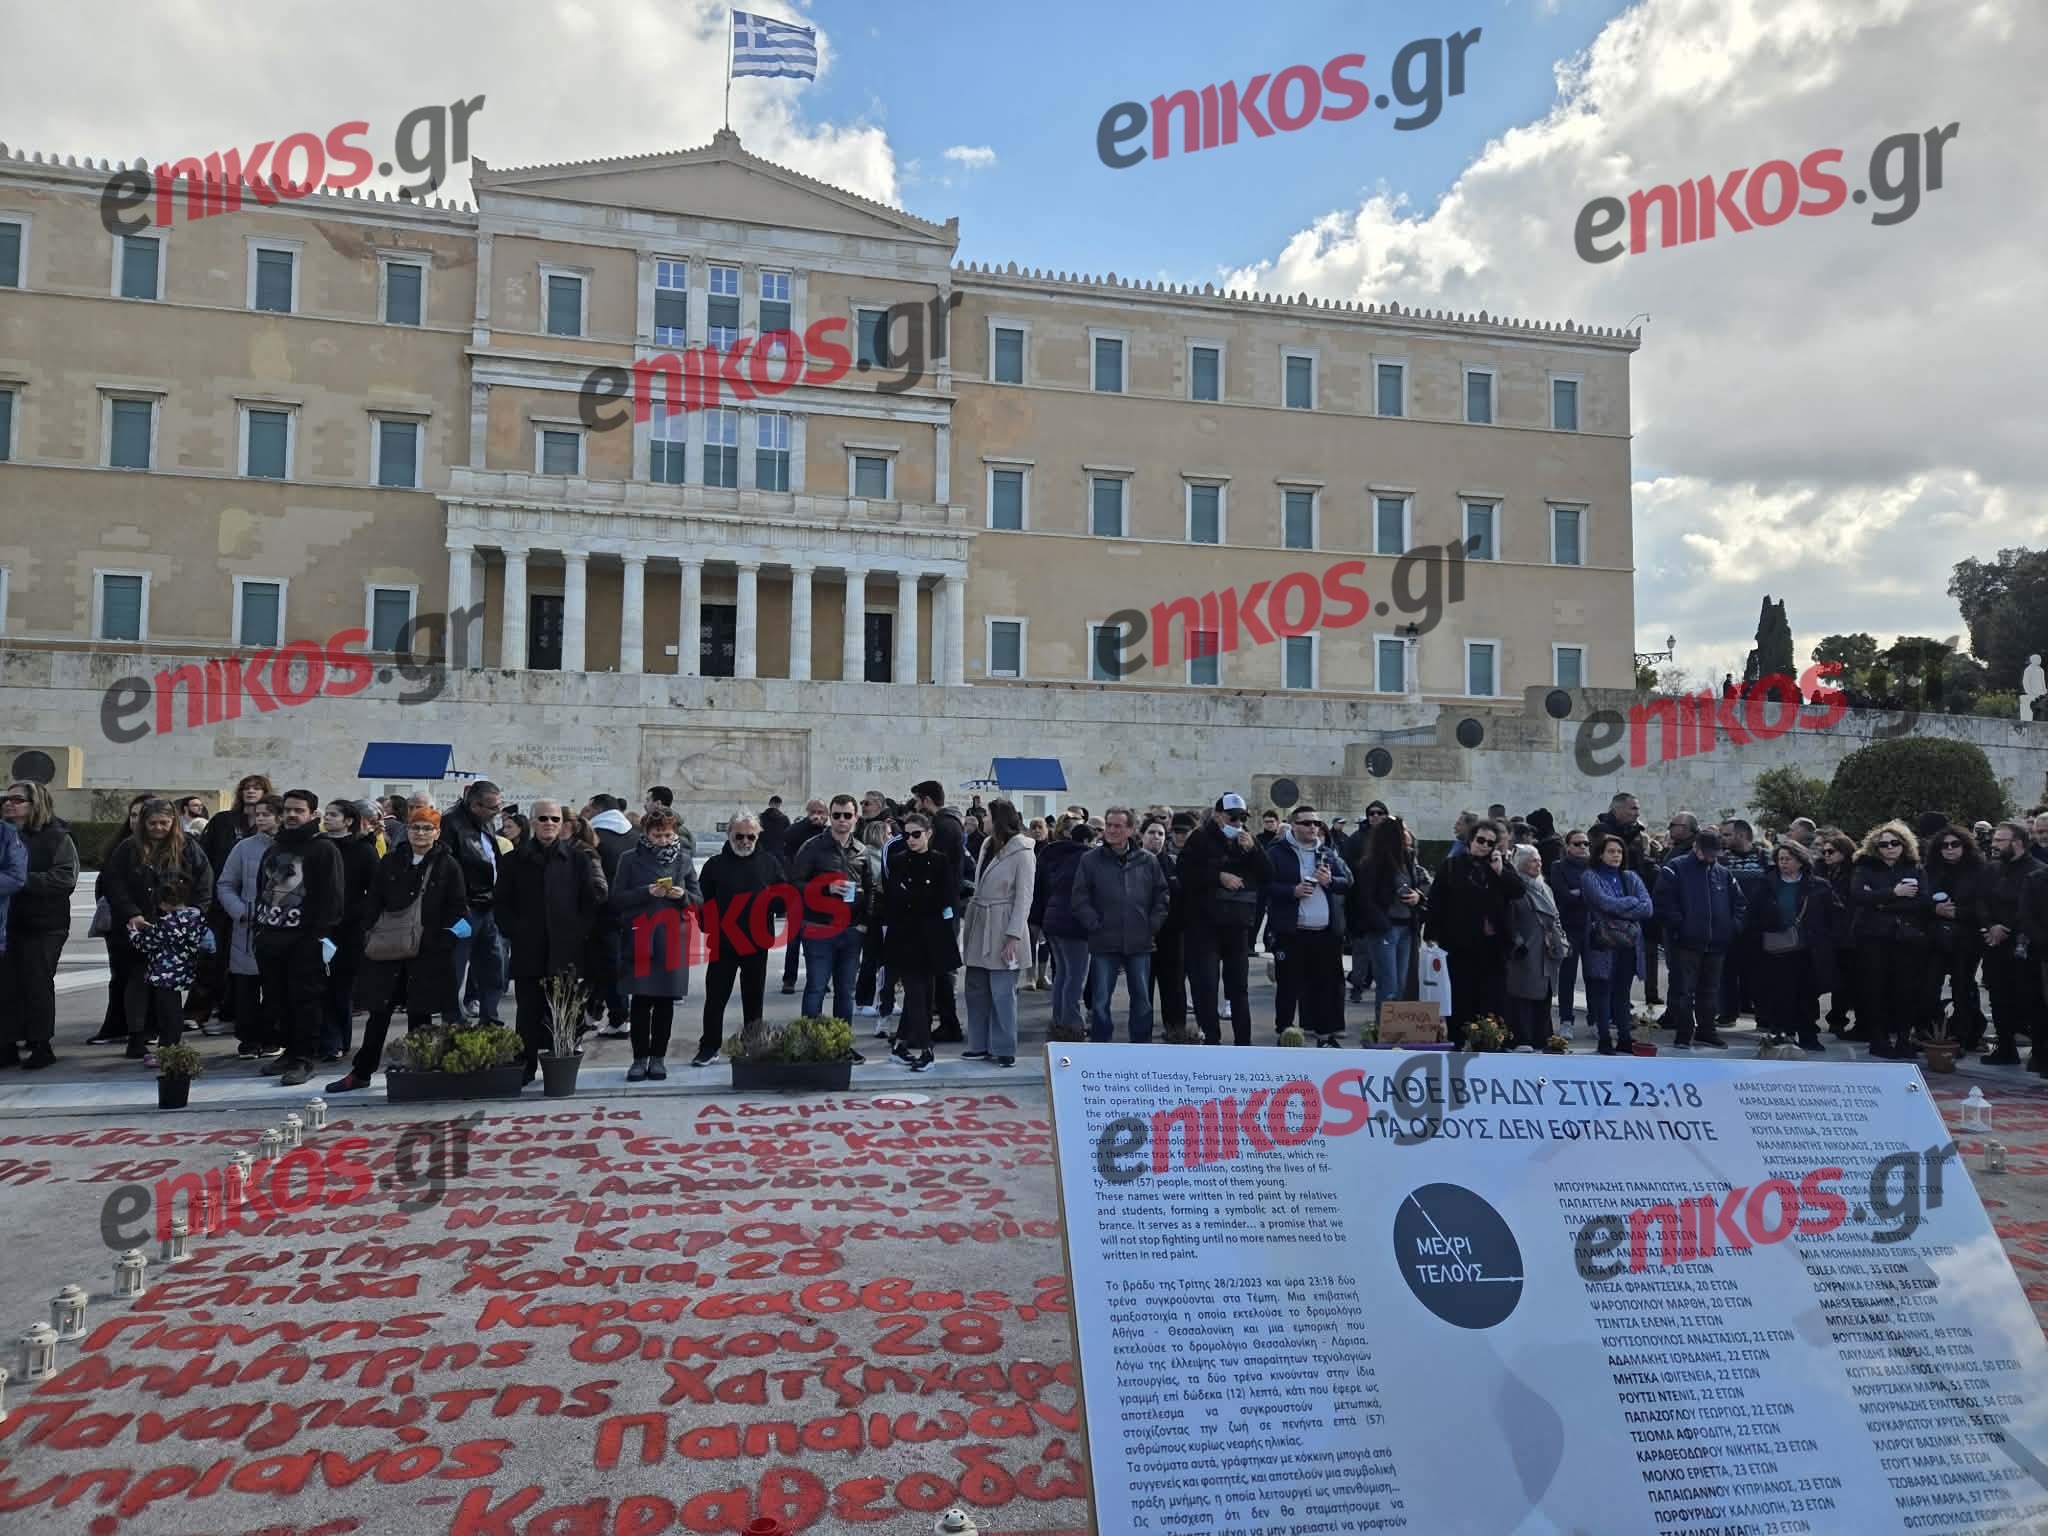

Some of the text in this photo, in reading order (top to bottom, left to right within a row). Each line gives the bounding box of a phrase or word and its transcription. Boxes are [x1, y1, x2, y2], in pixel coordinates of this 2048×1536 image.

[1080, 1070, 1095, 1079] On
[1096, 1070, 1112, 1079] the
[1114, 1071, 1139, 1081] night
[1141, 1072, 1150, 1080] of
[1151, 1072, 1190, 1082] Tuesday,
[1193, 1072, 1232, 1082] February
[1234, 1073, 1248, 1082] 28,
[1250, 1073, 1273, 1082] 2023,
[1276, 1074, 1284, 1082] at
[1358, 1076, 1703, 1107] ΚΑΘΕ ΒΡΑΔΥ ΣΤΙΣ 23:18
[1367, 1117, 1718, 1141] ΓΙΑ ΟΣΟΥΣ ΔΕΝ ΕΦΤΑΣΑΝ ΠΟΤΕ
[1095, 1190, 1336, 1202] These names were written in red paint by relatives
[1097, 1205, 1118, 1216] and
[1168, 1205, 1208, 1217] forming
[1213, 1207, 1220, 1215] a
[1223, 1204, 1266, 1216] symbolic
[1271, 1205, 1286, 1217] act
[1290, 1204, 1300, 1214] of
[1304, 1206, 1339, 1215] remem-
[1098, 1220, 1135, 1231] brance.
[1146, 1221, 1178, 1230] serves
[1181, 1221, 1192, 1230] as
[1194, 1221, 1200, 1229] a
[1259, 1220, 1266, 1229] a
[1268, 1219, 1305, 1230] promise
[1306, 1218, 1328, 1230] that
[1328, 1219, 1343, 1228] we
[1100, 1232, 1346, 1246] will not stop fighting until no more names need to be
[1416, 1236, 1472, 1255] ΜΕΧΡΙ
[1102, 1248, 1198, 1261] written in red paint.
[1415, 1263, 1484, 1283] ΤΕΛΟΥΣ
[871, 1311, 1004, 1356] 28
